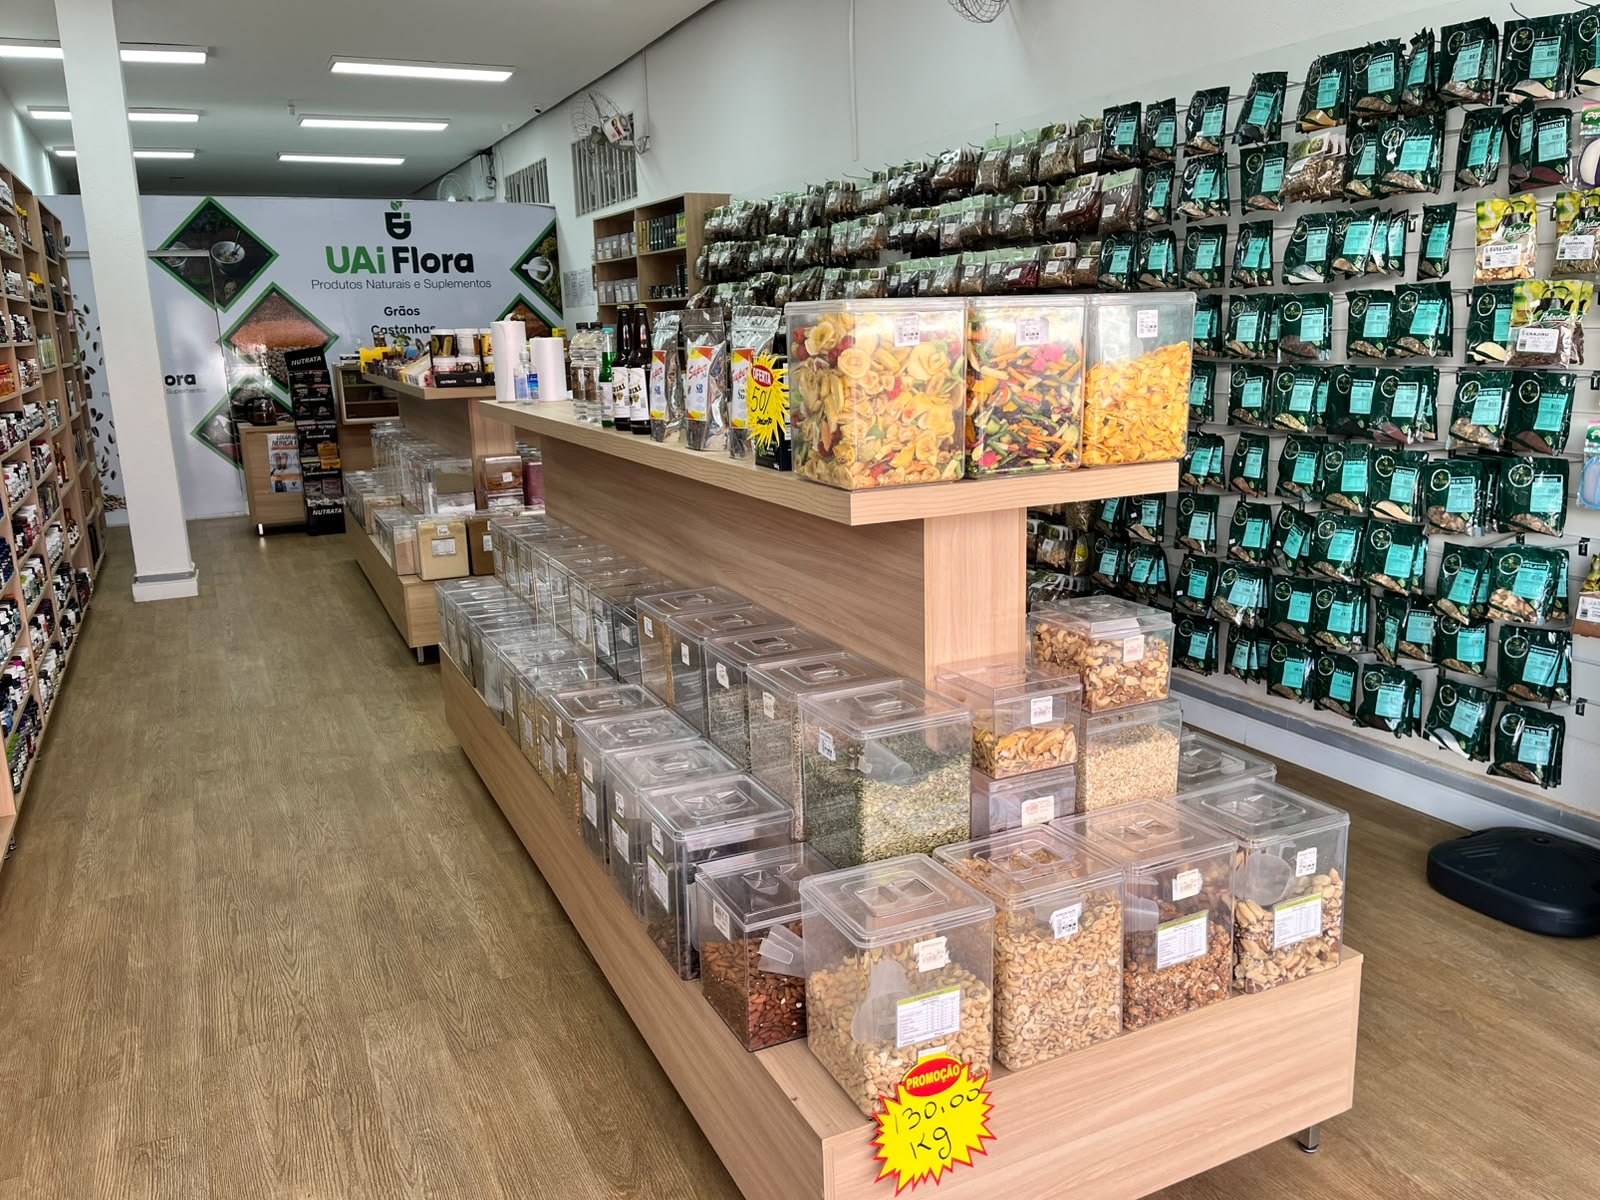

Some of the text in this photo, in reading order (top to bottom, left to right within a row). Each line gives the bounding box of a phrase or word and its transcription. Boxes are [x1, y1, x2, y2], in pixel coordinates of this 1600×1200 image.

[1540, 121, 1564, 131] HIBISCO
[391, 246, 475, 274] Flora
[311, 278, 492, 291] Produtos Naturais e Suplementos
[383, 305, 420, 317] Grãos
[291, 355, 322, 367] NUTRATA
[164, 374, 197, 387] ora
[753, 366, 771, 386] OFERTA
[751, 386, 773, 415] 50%
[312, 507, 343, 517] NUTRATA
[906, 1064, 960, 1090] PROMOÇÃO
